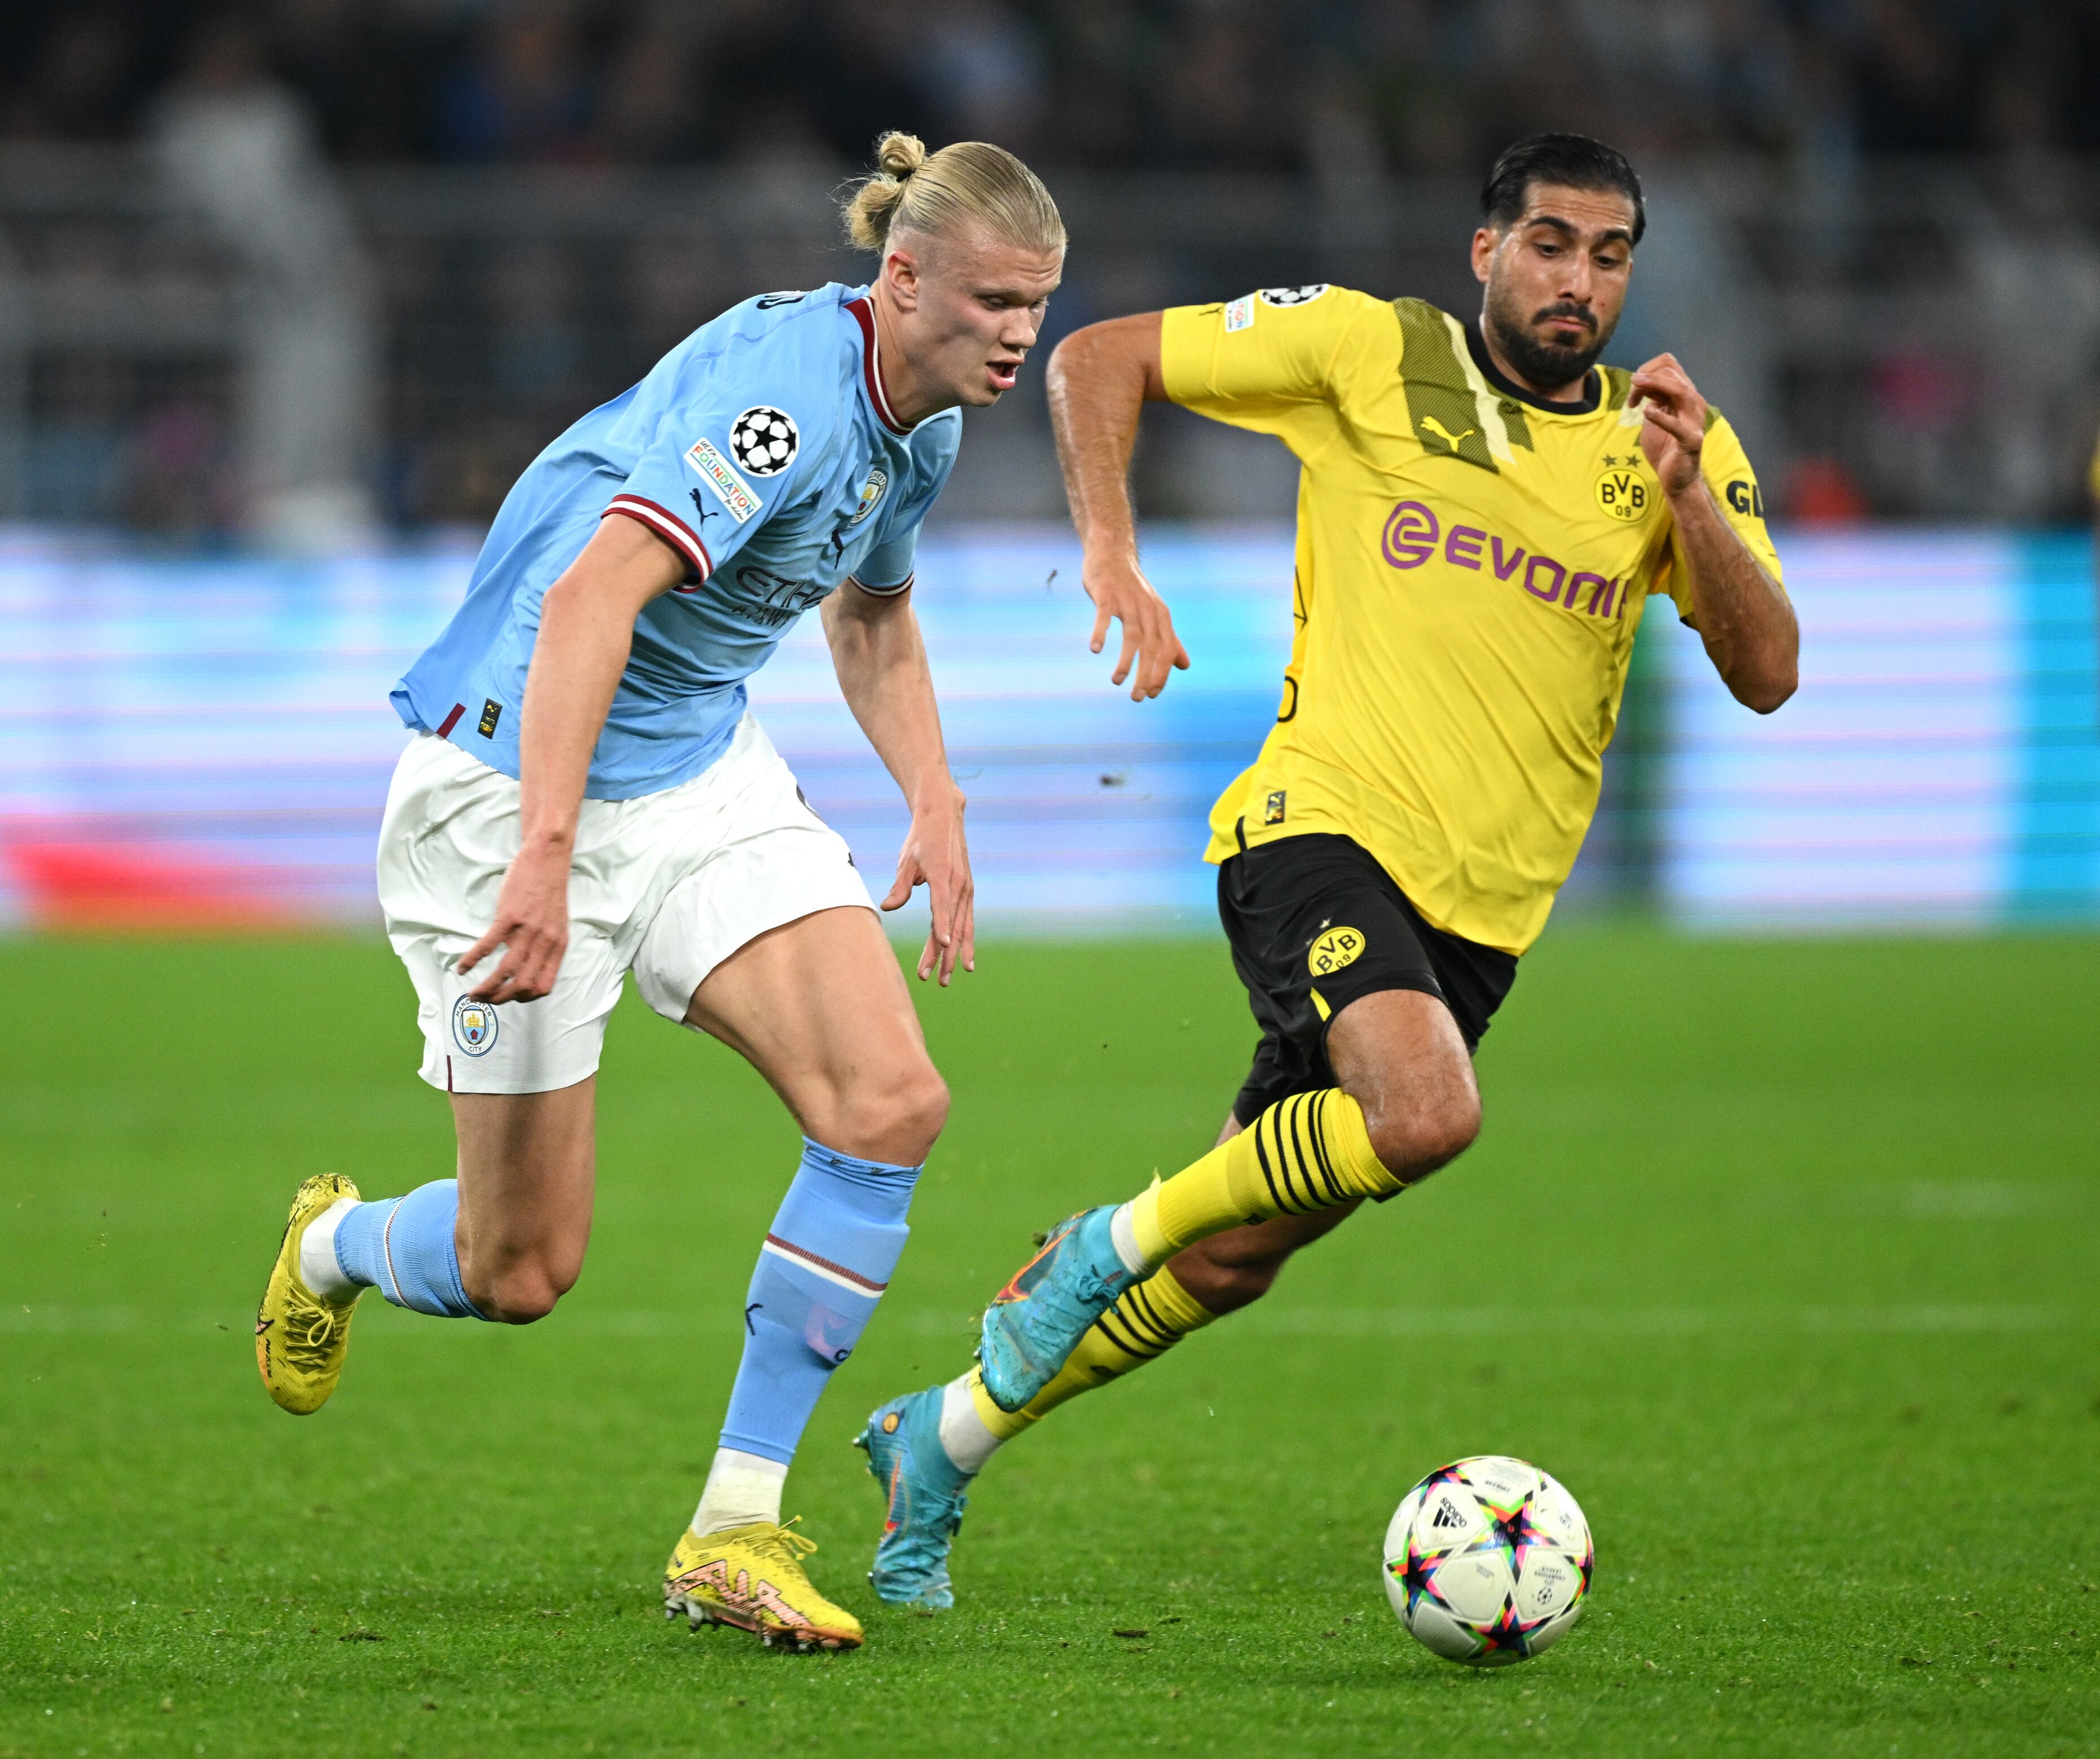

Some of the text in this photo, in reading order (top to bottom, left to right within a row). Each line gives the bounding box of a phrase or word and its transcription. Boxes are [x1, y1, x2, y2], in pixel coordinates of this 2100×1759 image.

[700, 441, 716, 456] UEFA
[693, 445, 754, 515] FOUNDATION
[1602, 473, 1645, 508] BVB
[1615, 505, 1631, 517] 09
[1316, 934, 1357, 973] BVB
[1335, 954, 1351, 969] 09
[456, 999, 492, 1018] MANCSTER
[1440, 1497, 1467, 1528] adidas
